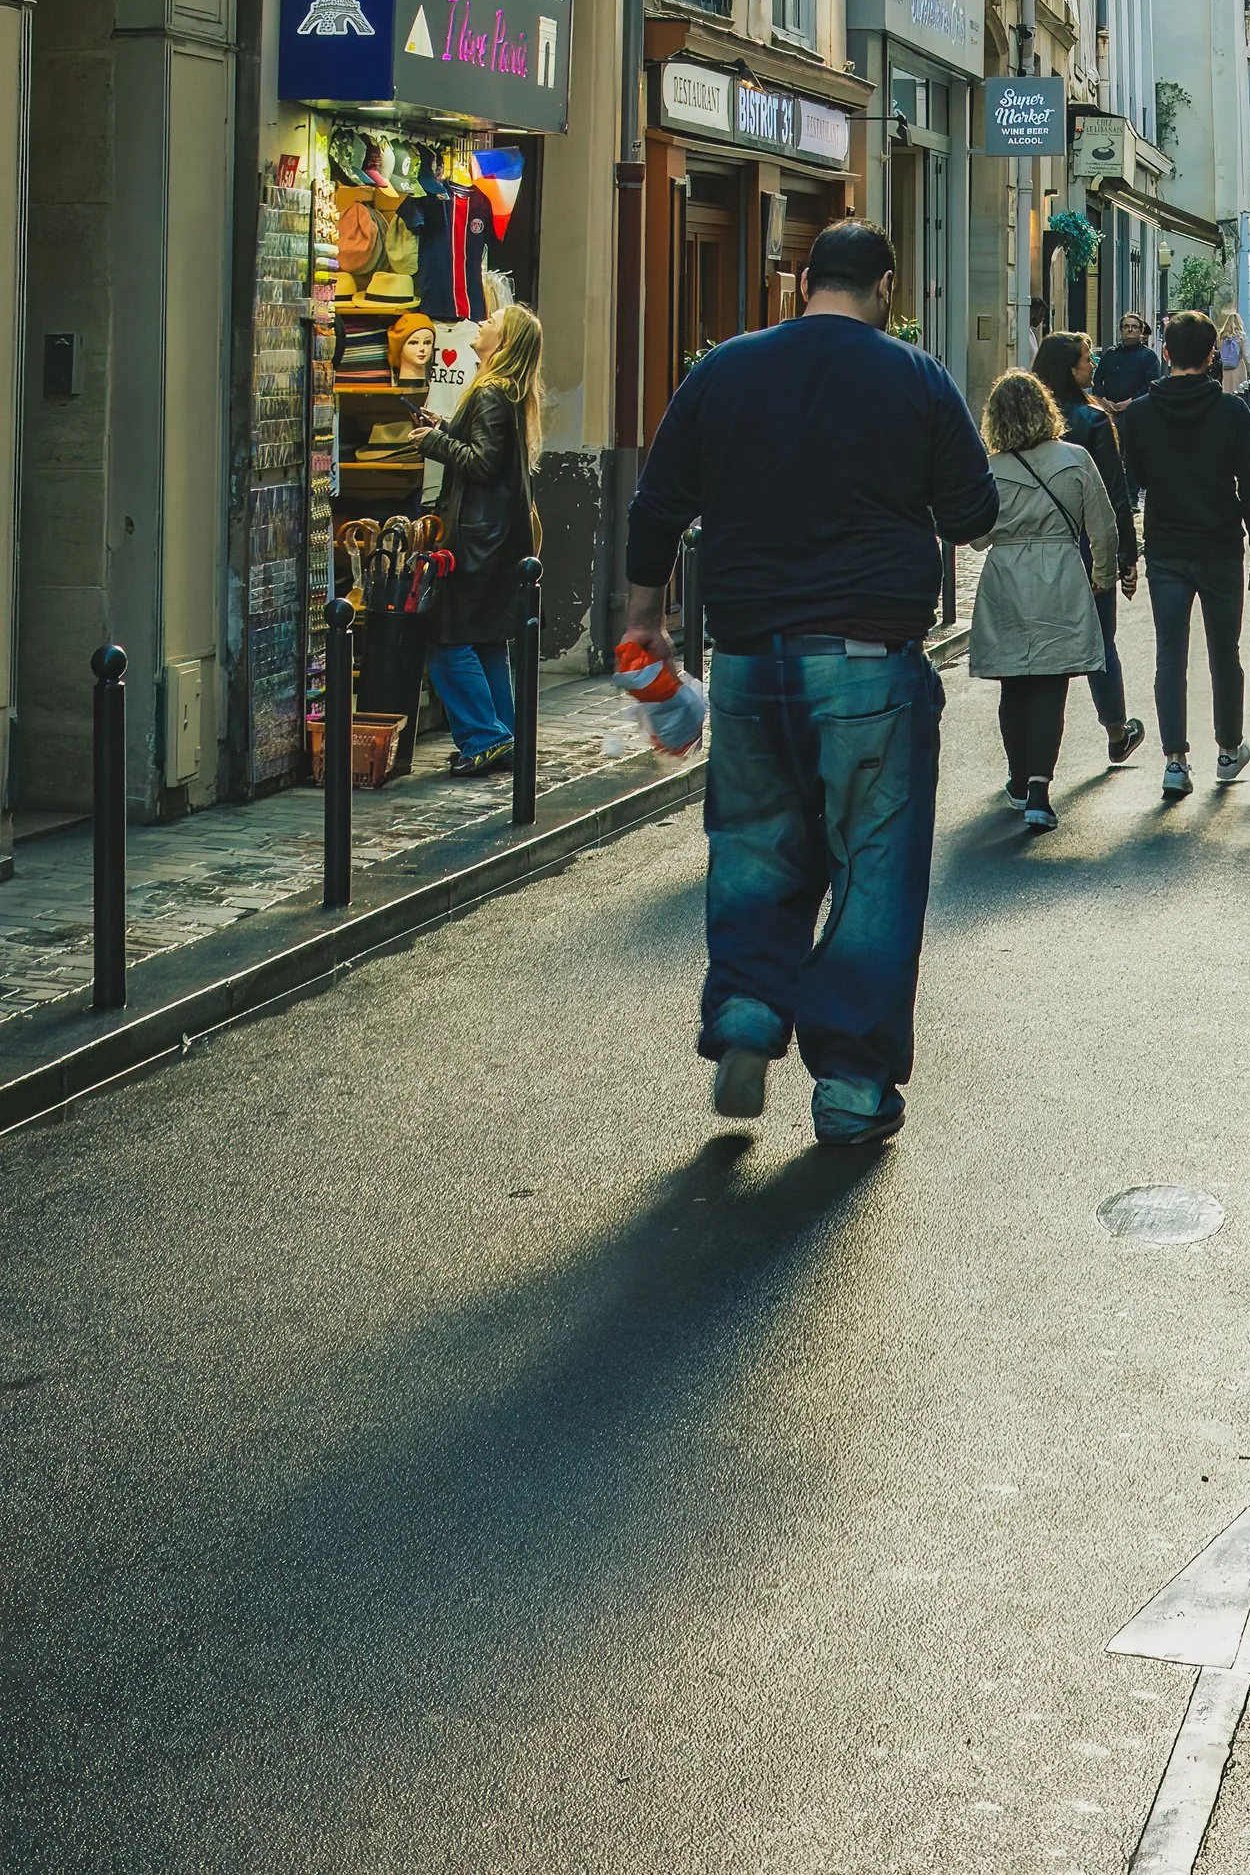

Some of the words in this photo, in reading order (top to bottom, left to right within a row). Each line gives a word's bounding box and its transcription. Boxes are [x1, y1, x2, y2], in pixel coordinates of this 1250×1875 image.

[673, 76, 720, 113] RESTAURANT
[999, 88, 1045, 110] Super
[739, 86, 779, 141] BISTROT
[781, 98, 794, 145] 31
[994, 107, 1055, 126] Market
[1001, 127, 1025, 135] WINE
[1026, 127, 1049, 135] BEER
[1008, 137, 1043, 145] ALCOOL
[430, 367, 465, 385] ARIS
